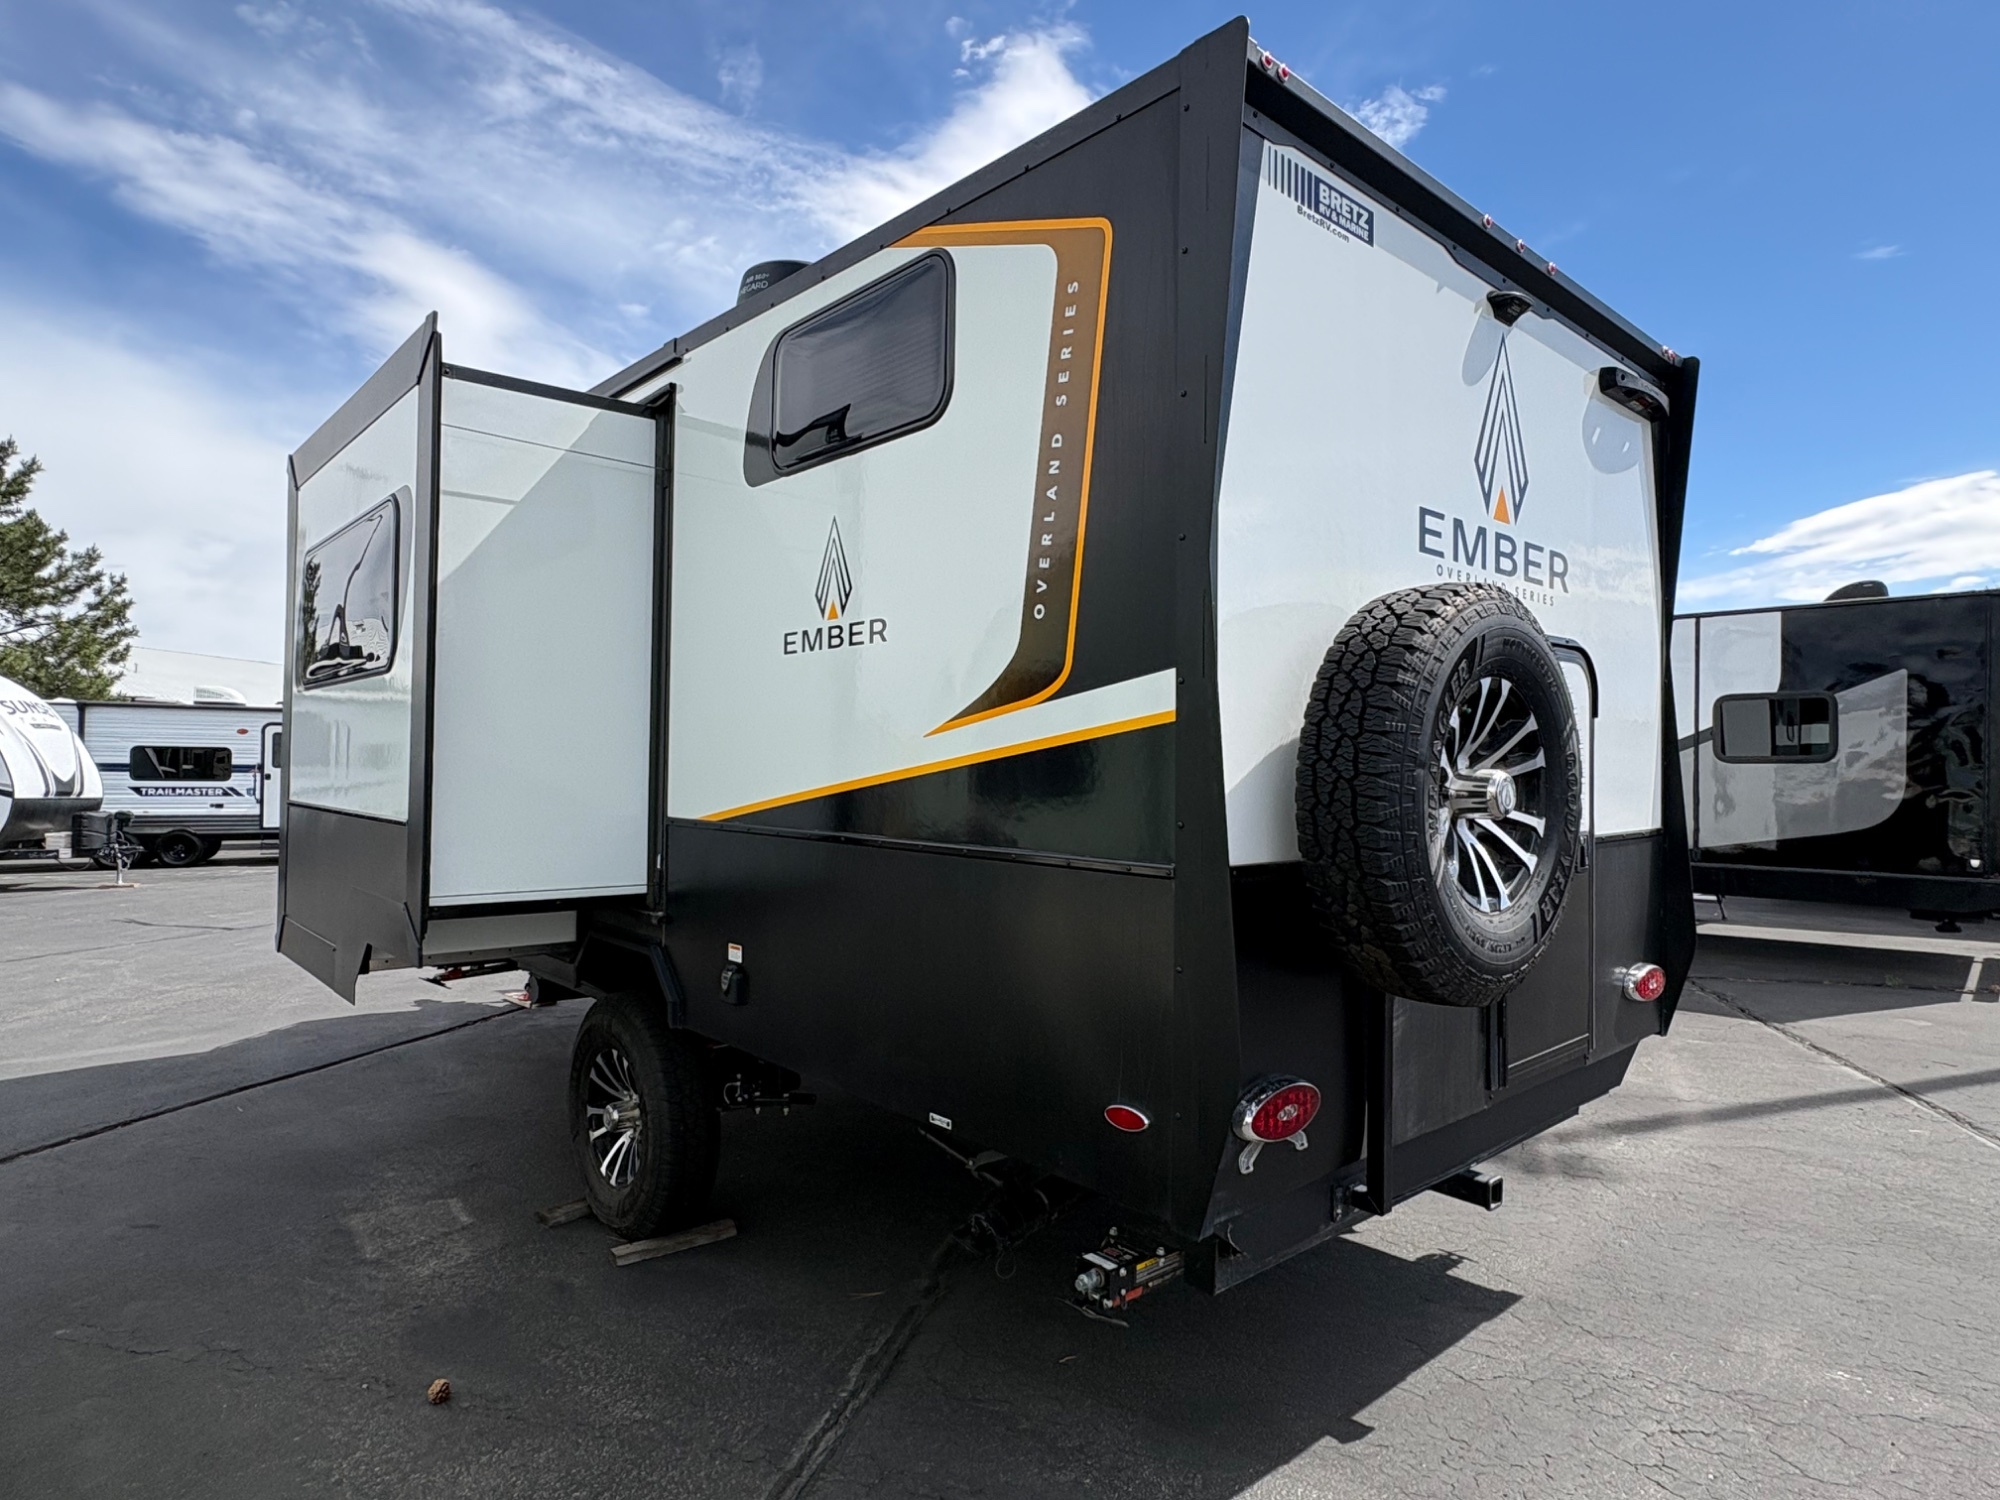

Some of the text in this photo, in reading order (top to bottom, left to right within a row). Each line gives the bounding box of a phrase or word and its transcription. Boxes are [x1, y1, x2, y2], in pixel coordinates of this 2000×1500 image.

[1297, 204, 1350, 243] BretzRV.com
[1319, 182, 1369, 230] BRETZ
[1319, 203, 1369, 242] RV & MARINE
[1033, 281, 1079, 620] OVERLAND SERIES
[1419, 506, 1570, 595] EMBER
[1514, 586, 1555, 607] SERIES
[783, 617, 888, 655] EMBER
[140, 787, 223, 798] TRAILMASTER
